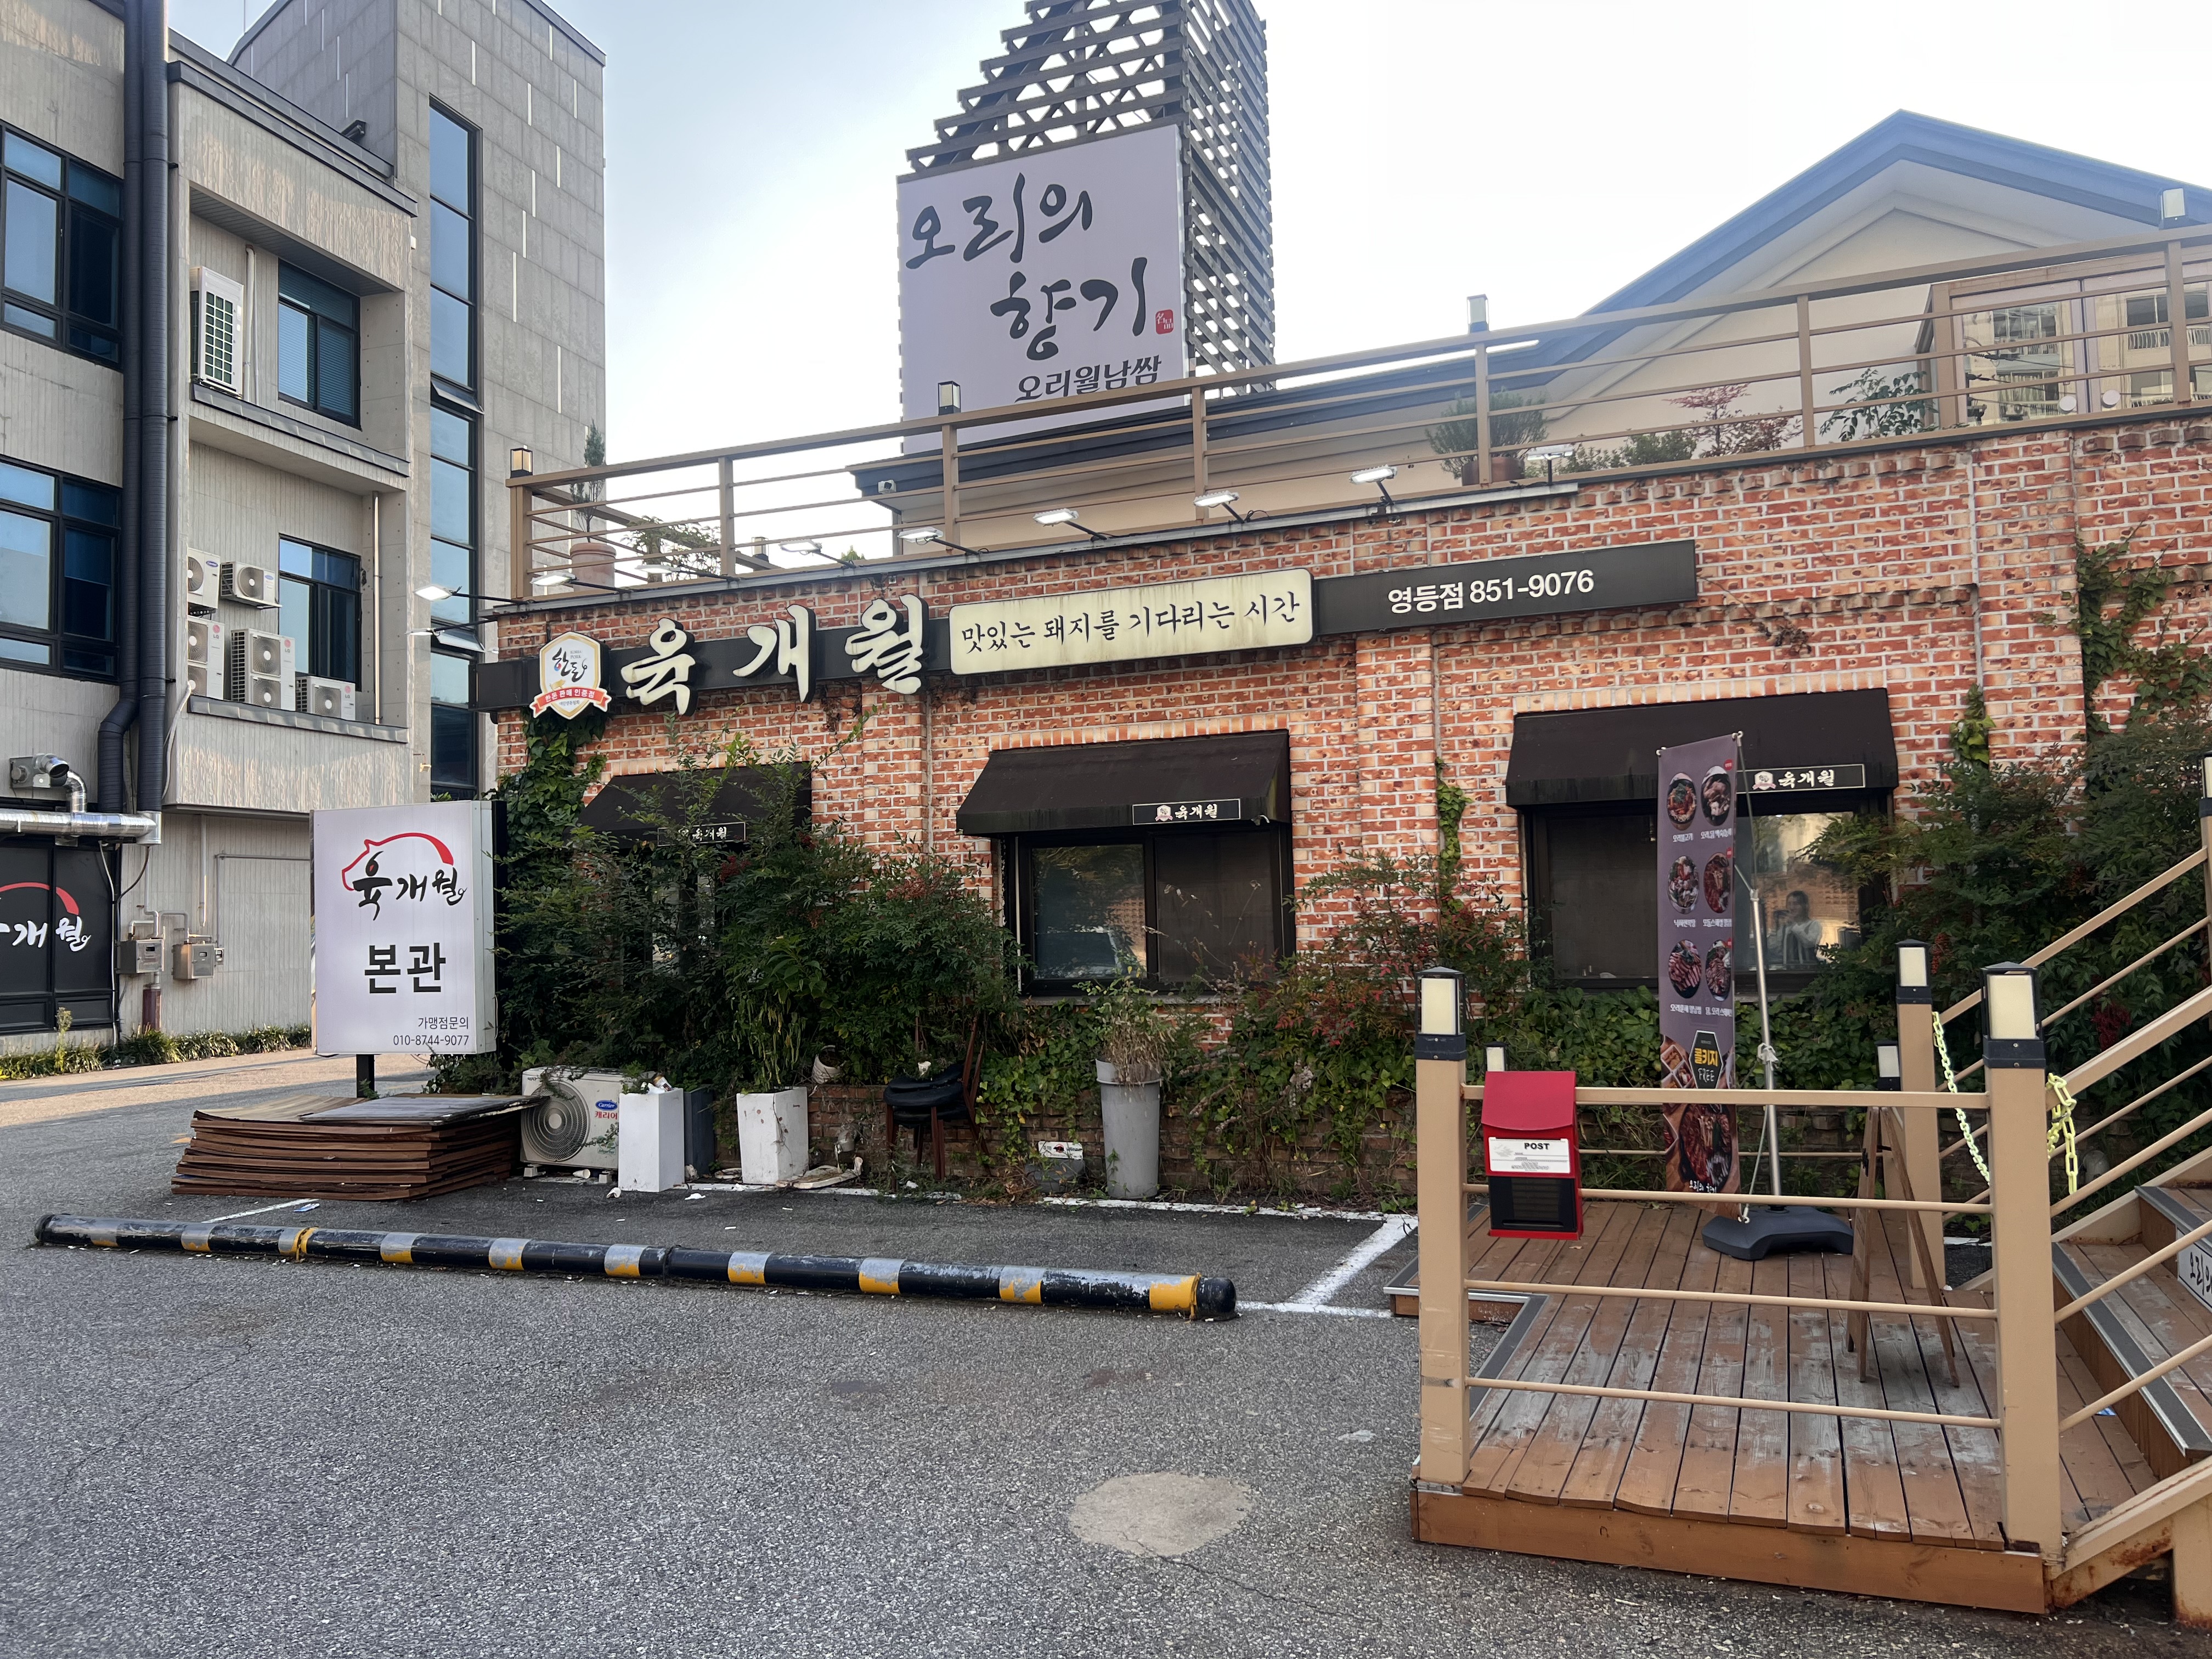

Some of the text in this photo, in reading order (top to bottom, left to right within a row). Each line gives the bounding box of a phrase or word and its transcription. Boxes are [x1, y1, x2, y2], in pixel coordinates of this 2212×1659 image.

[906, 172, 1093, 269] 오리의
[990, 257, 1148, 360] 향기
[1014, 354, 1162, 403] 오리월남쌈
[1387, 569, 1594, 614] 영등점 851-9076
[961, 590, 1300, 654] 맛있는 돼지를 기다리는 시간
[620, 594, 925, 715] 육개월
[545, 692, 558, 702] 한돈
[574, 689, 595, 699] 인증점
[1778, 769, 1835, 789] 육개월
[1175, 803, 1217, 820] 육개월
[352, 851, 467, 921] 육개월
[0, 914, 91, 952] 개월
[364, 942, 447, 994] 본관
[393, 1035, 470, 1046] 010-8744-9077
[418, 1016, 469, 1030] 가맹점문의
[1694, 1047, 1718, 1067] 콜키지
[1697, 1068, 1716, 1083] FREE
[595, 1111, 618, 1120] 캐리어
